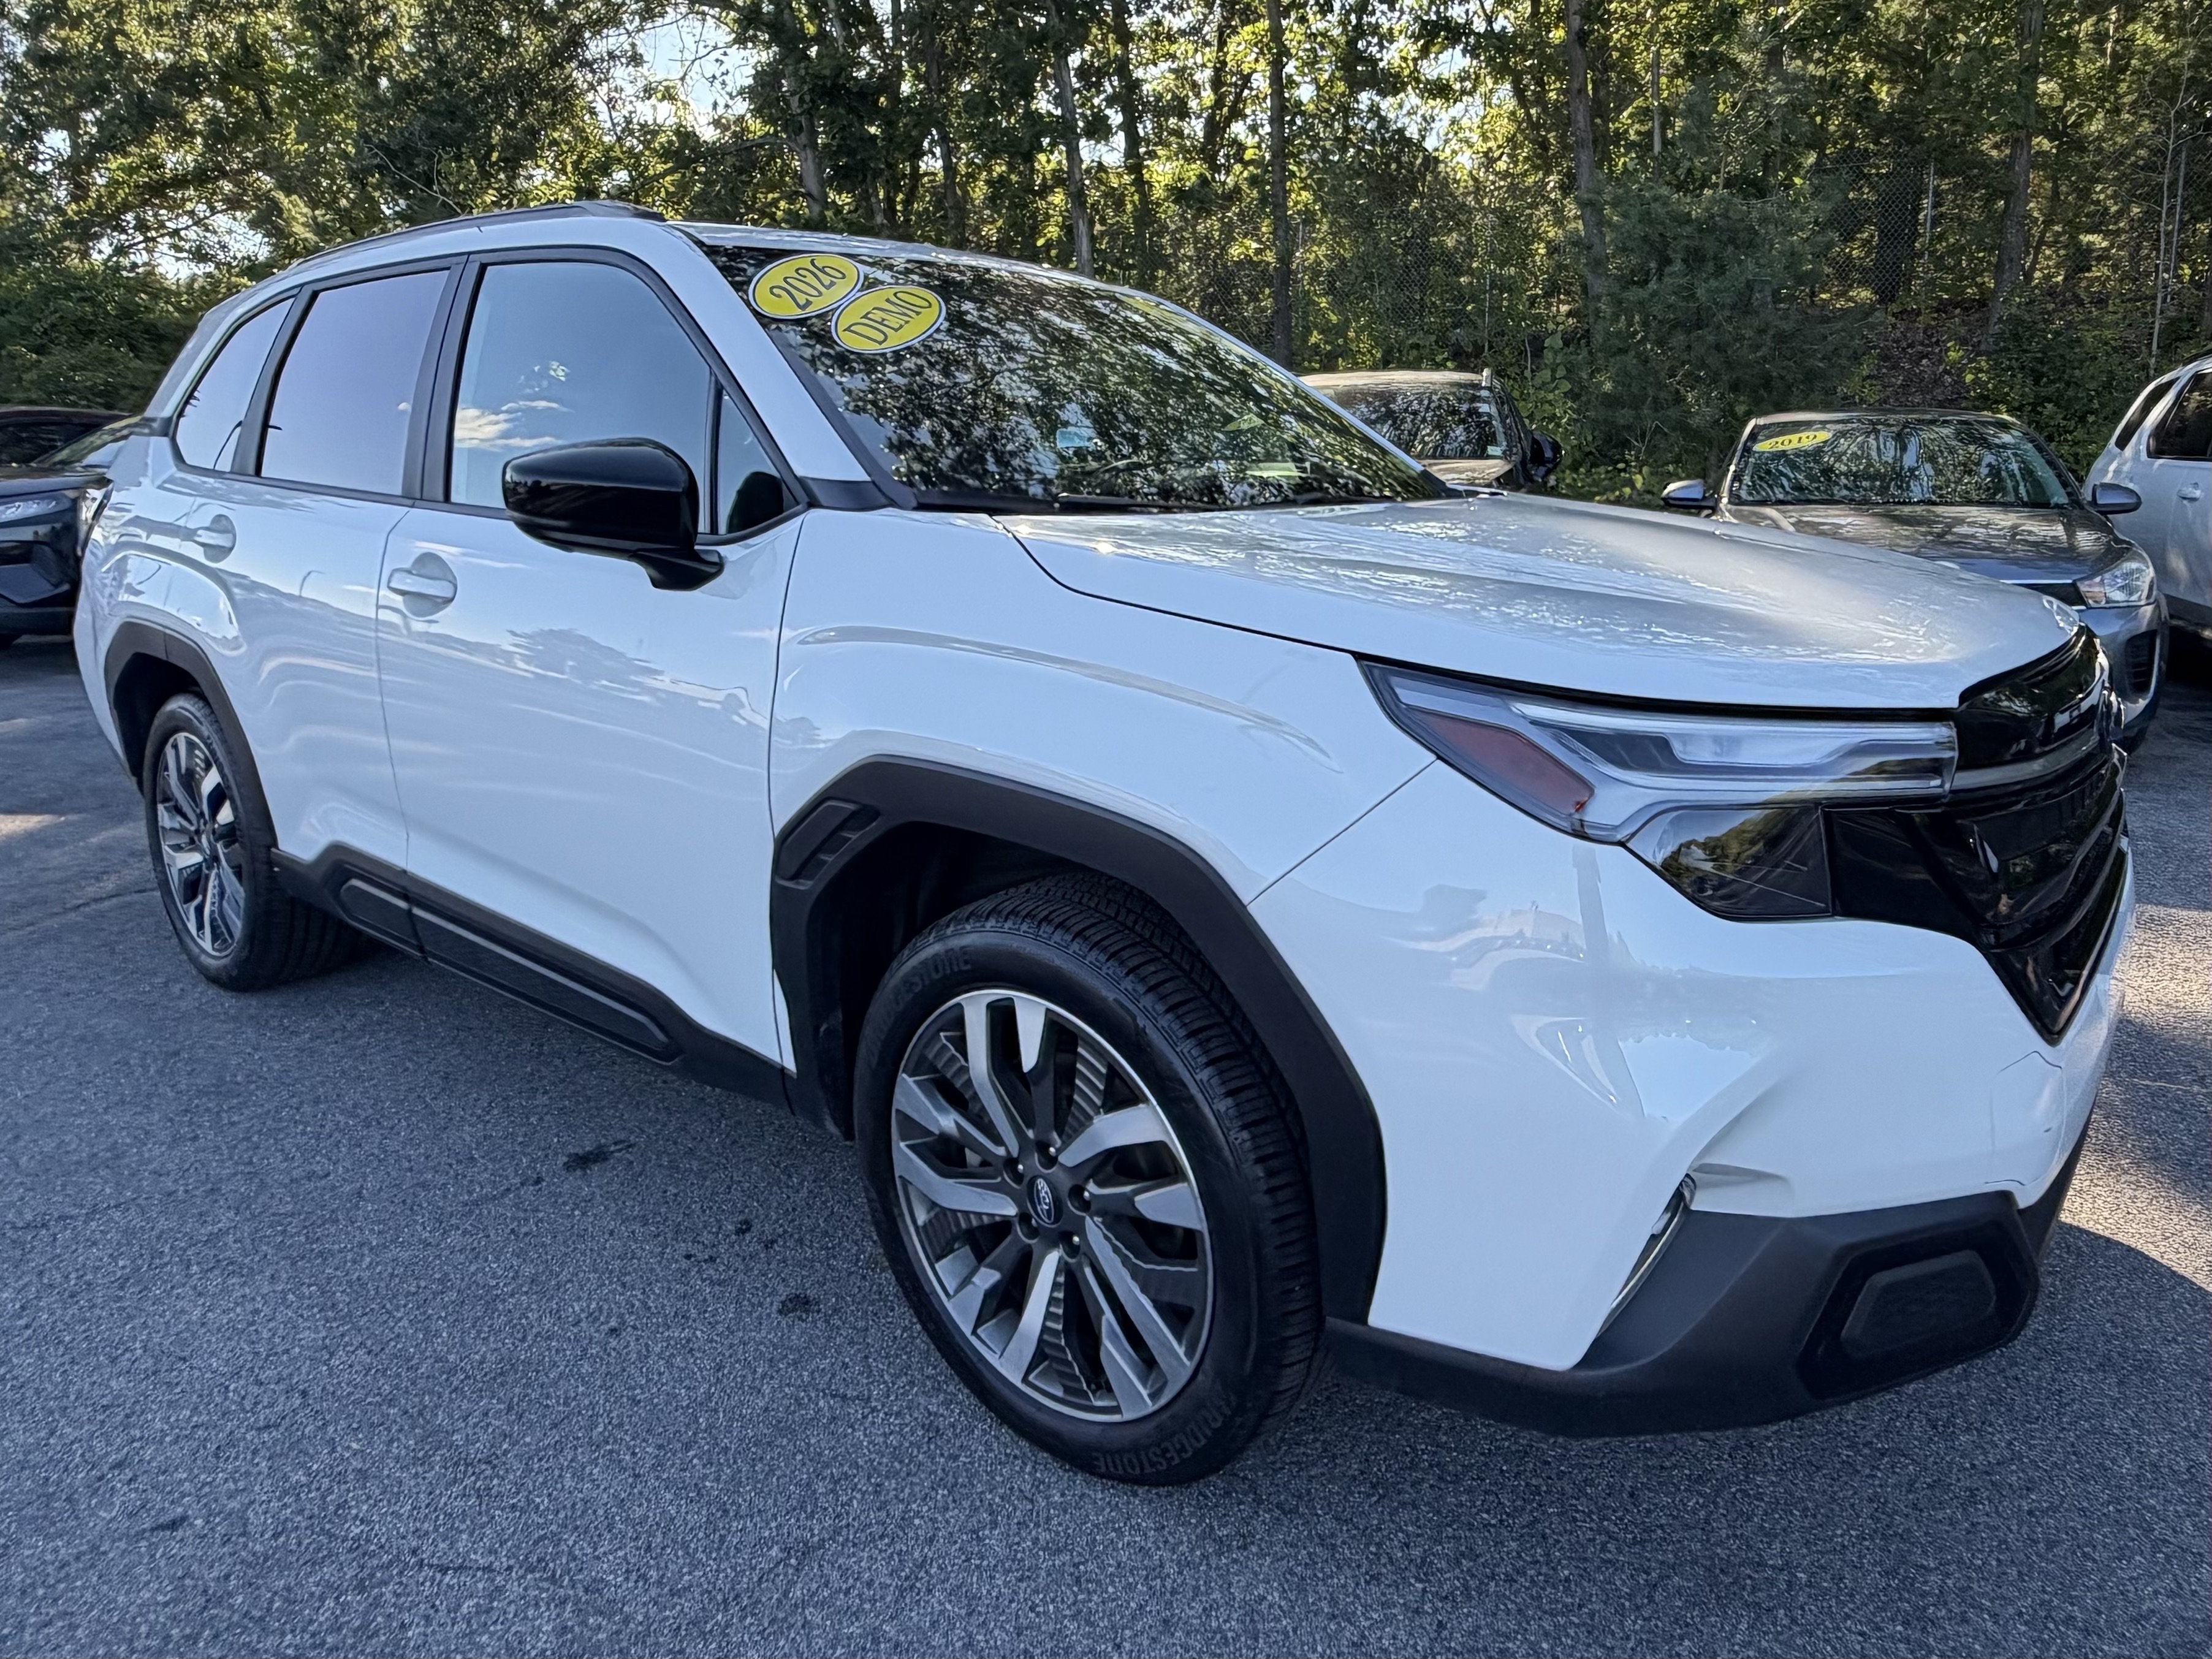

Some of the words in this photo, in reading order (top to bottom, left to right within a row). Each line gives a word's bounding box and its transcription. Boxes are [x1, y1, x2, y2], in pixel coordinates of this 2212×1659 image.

[769, 259, 846, 311] 2026
[842, 290, 932, 346] DEMO
[1768, 434, 1817, 449] 2019
